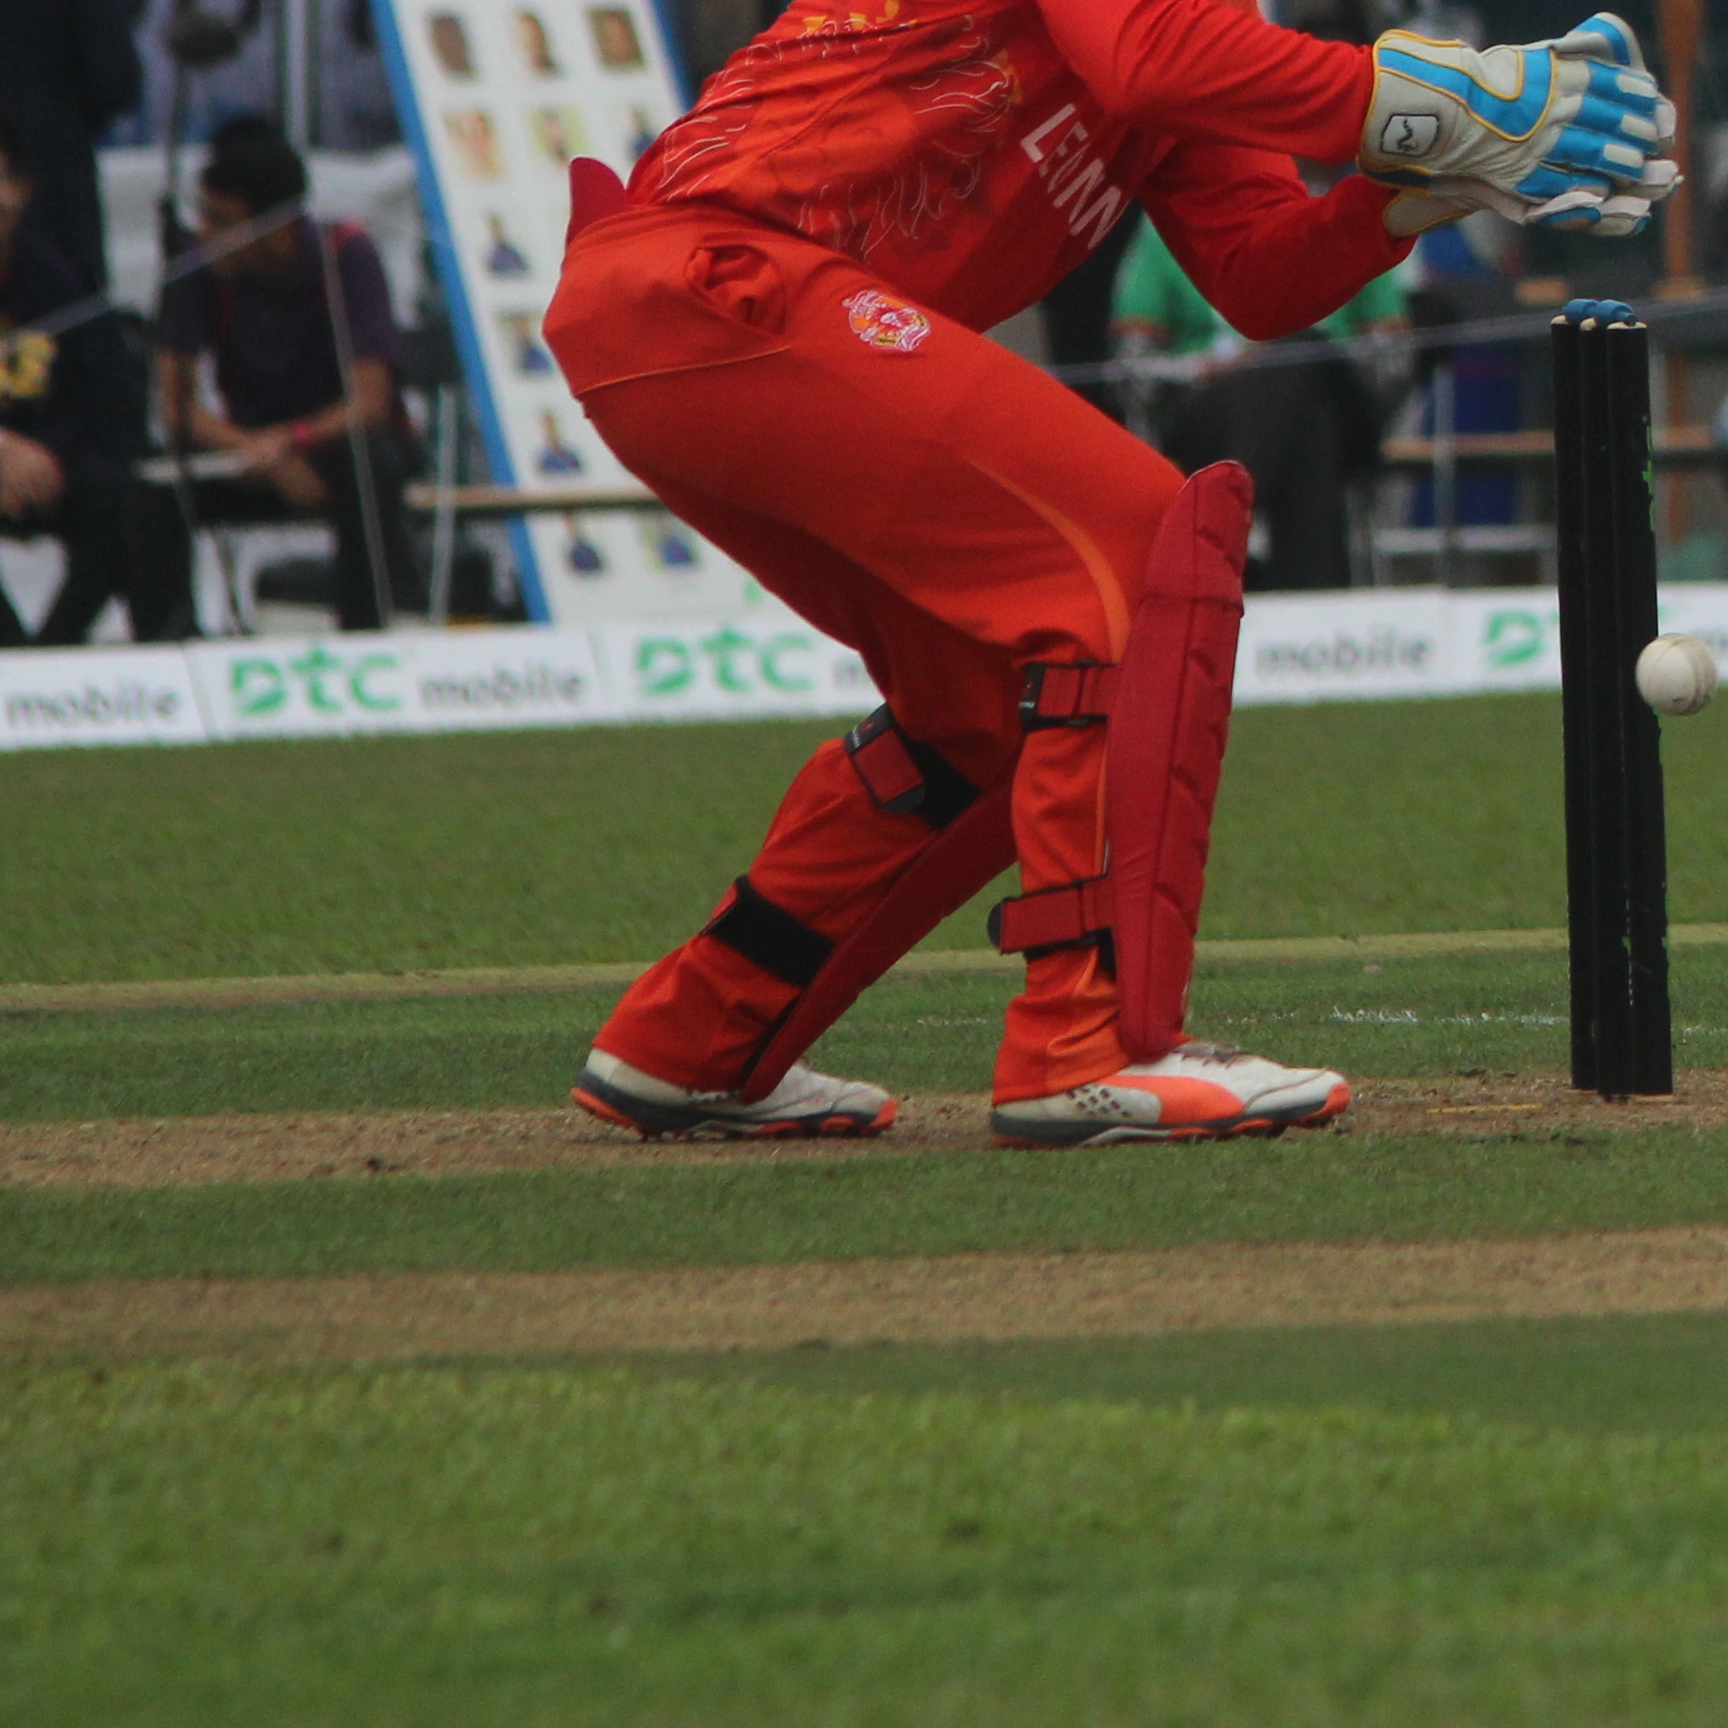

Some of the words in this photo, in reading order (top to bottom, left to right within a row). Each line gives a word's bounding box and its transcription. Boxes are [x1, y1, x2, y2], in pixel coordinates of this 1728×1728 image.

[1256, 624, 1432, 676] mobile
[4, 676, 183, 730] mobile
[420, 662, 587, 710] mobile
